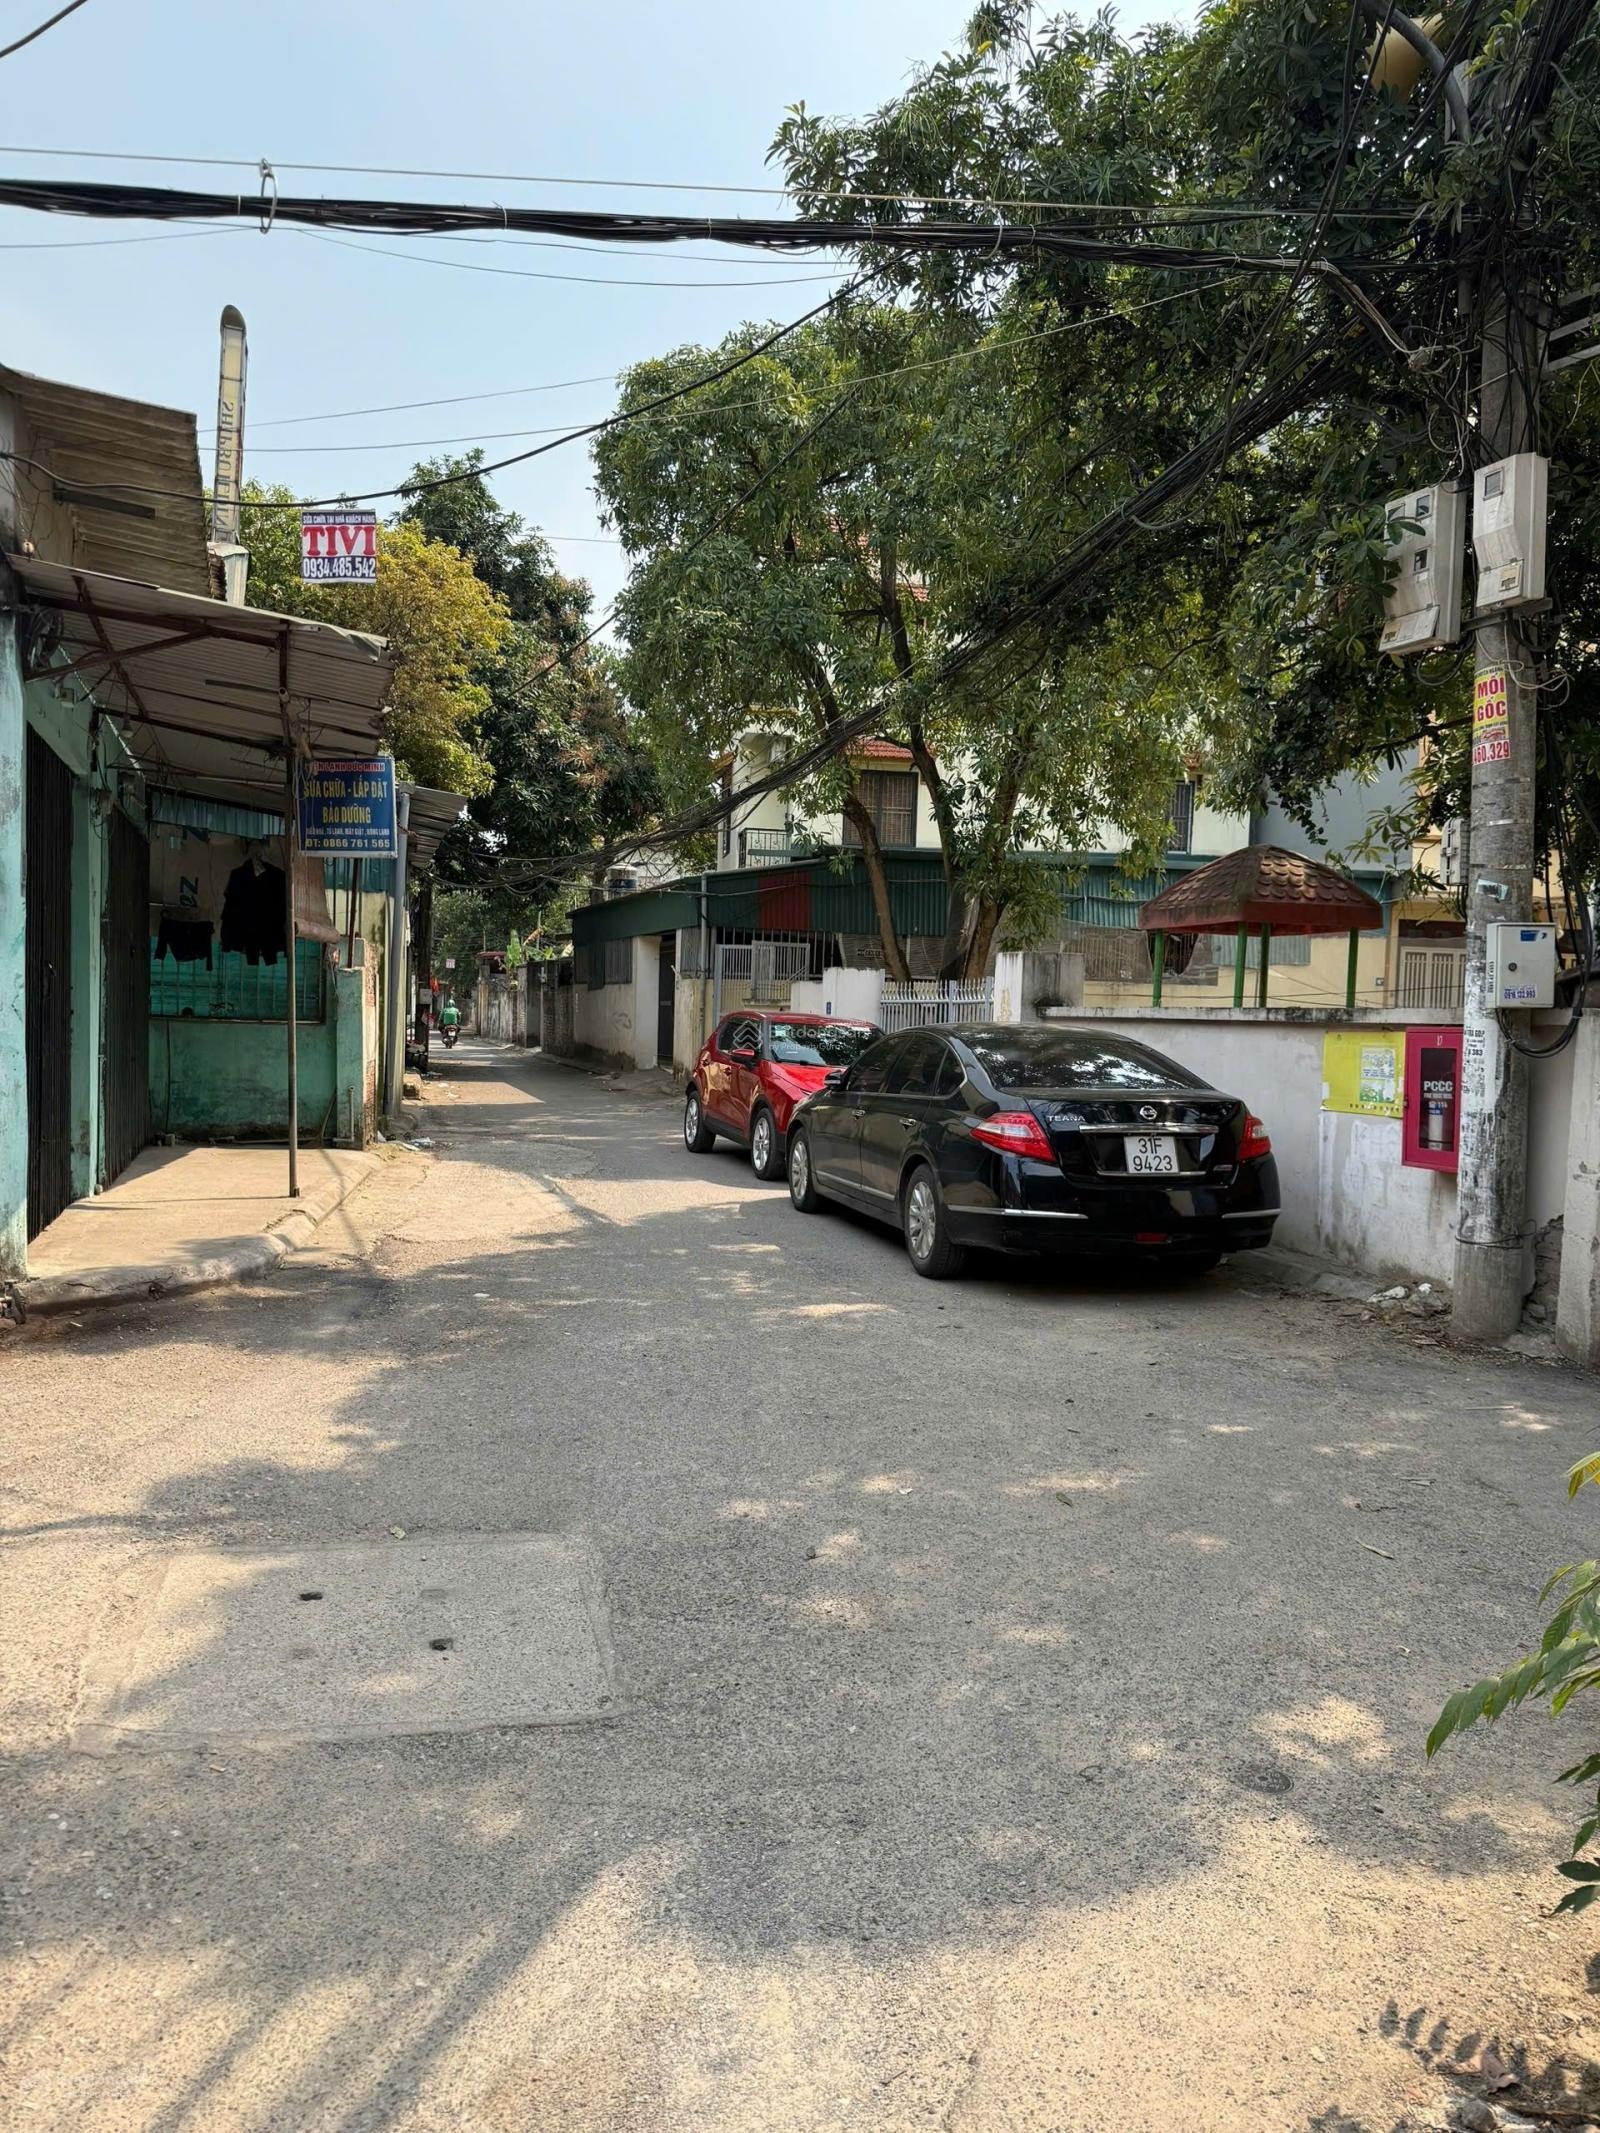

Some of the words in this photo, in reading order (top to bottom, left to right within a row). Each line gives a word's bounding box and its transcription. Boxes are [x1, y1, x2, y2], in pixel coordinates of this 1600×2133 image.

[303, 526, 376, 556] TIVI
[303, 557, 376, 578] 0934.485.542
[1477, 696, 1506, 722] GỐC
[1423, 1080, 1454, 1091] PCCC
[1138, 1137, 1163, 1154] 31F
[1133, 1155, 1173, 1172] 9423
